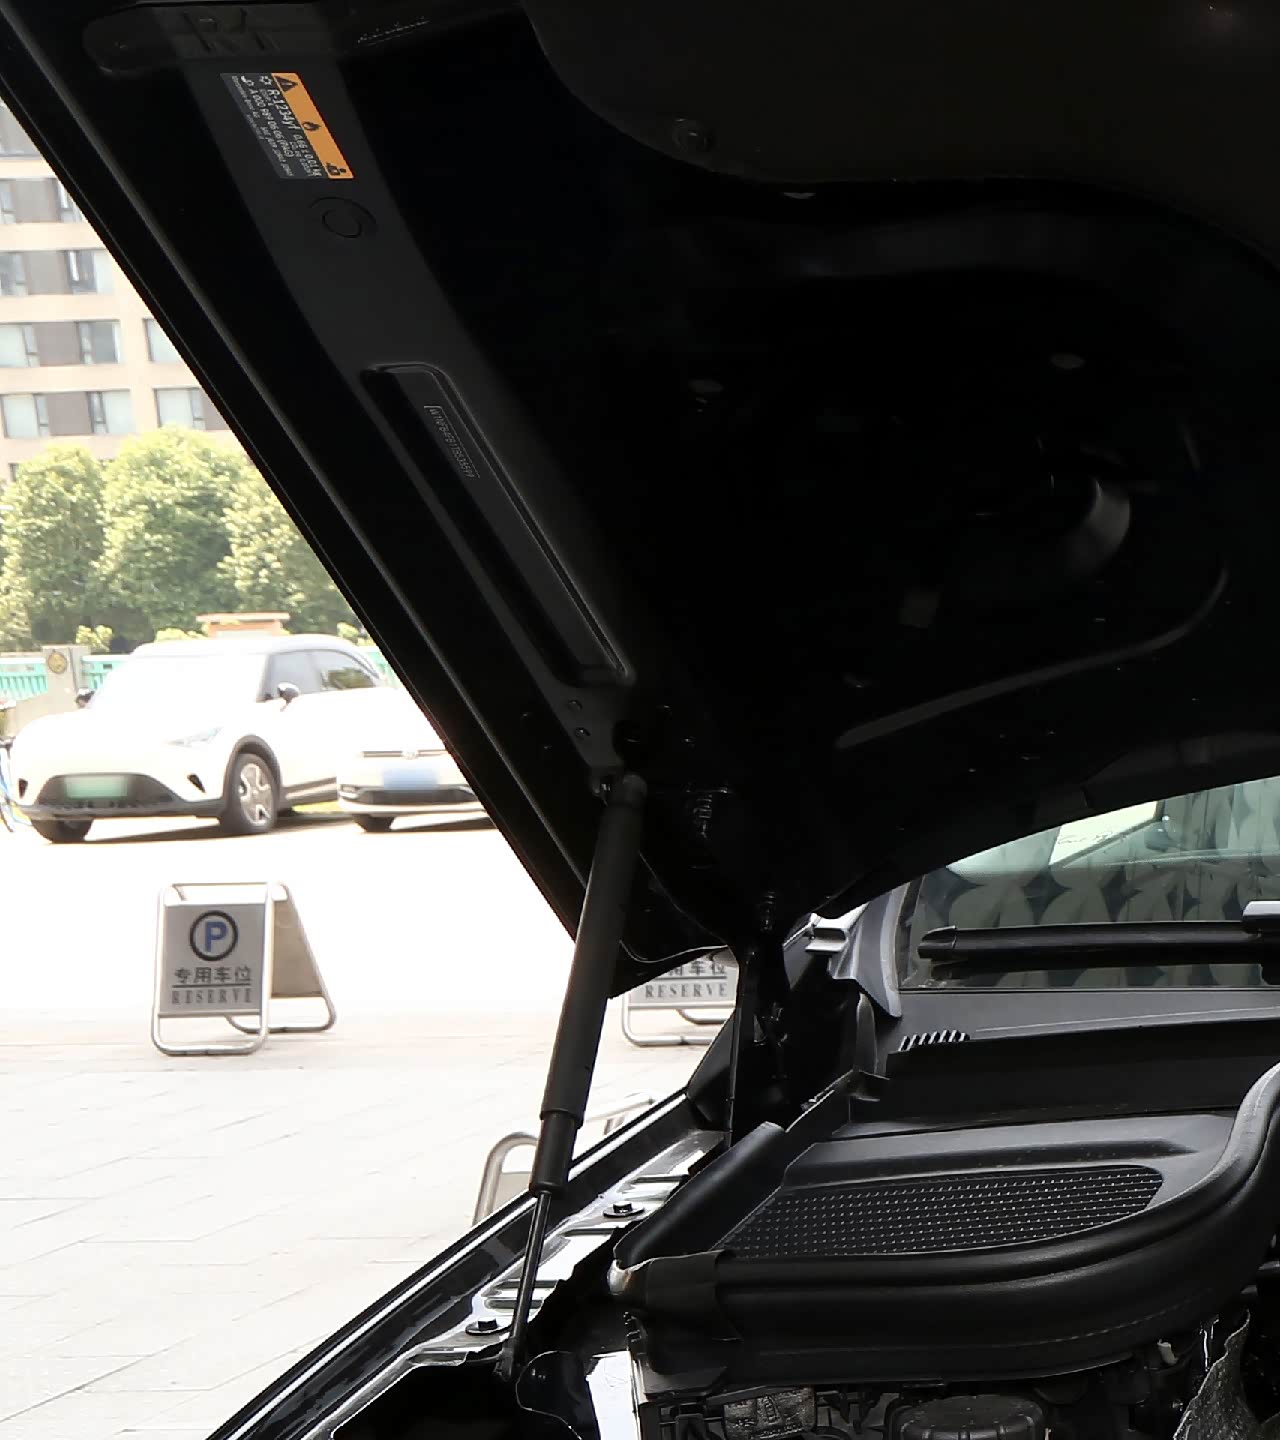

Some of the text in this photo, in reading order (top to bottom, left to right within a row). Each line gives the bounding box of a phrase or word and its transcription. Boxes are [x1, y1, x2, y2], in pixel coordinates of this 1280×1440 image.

[267, 88, 301, 130] R-1234yf
[205, 921, 228, 952] P
[174, 965, 251, 984] 专用车位
[172, 988, 252, 1004] RESERVE
[645, 983, 728, 998] RESERVE
